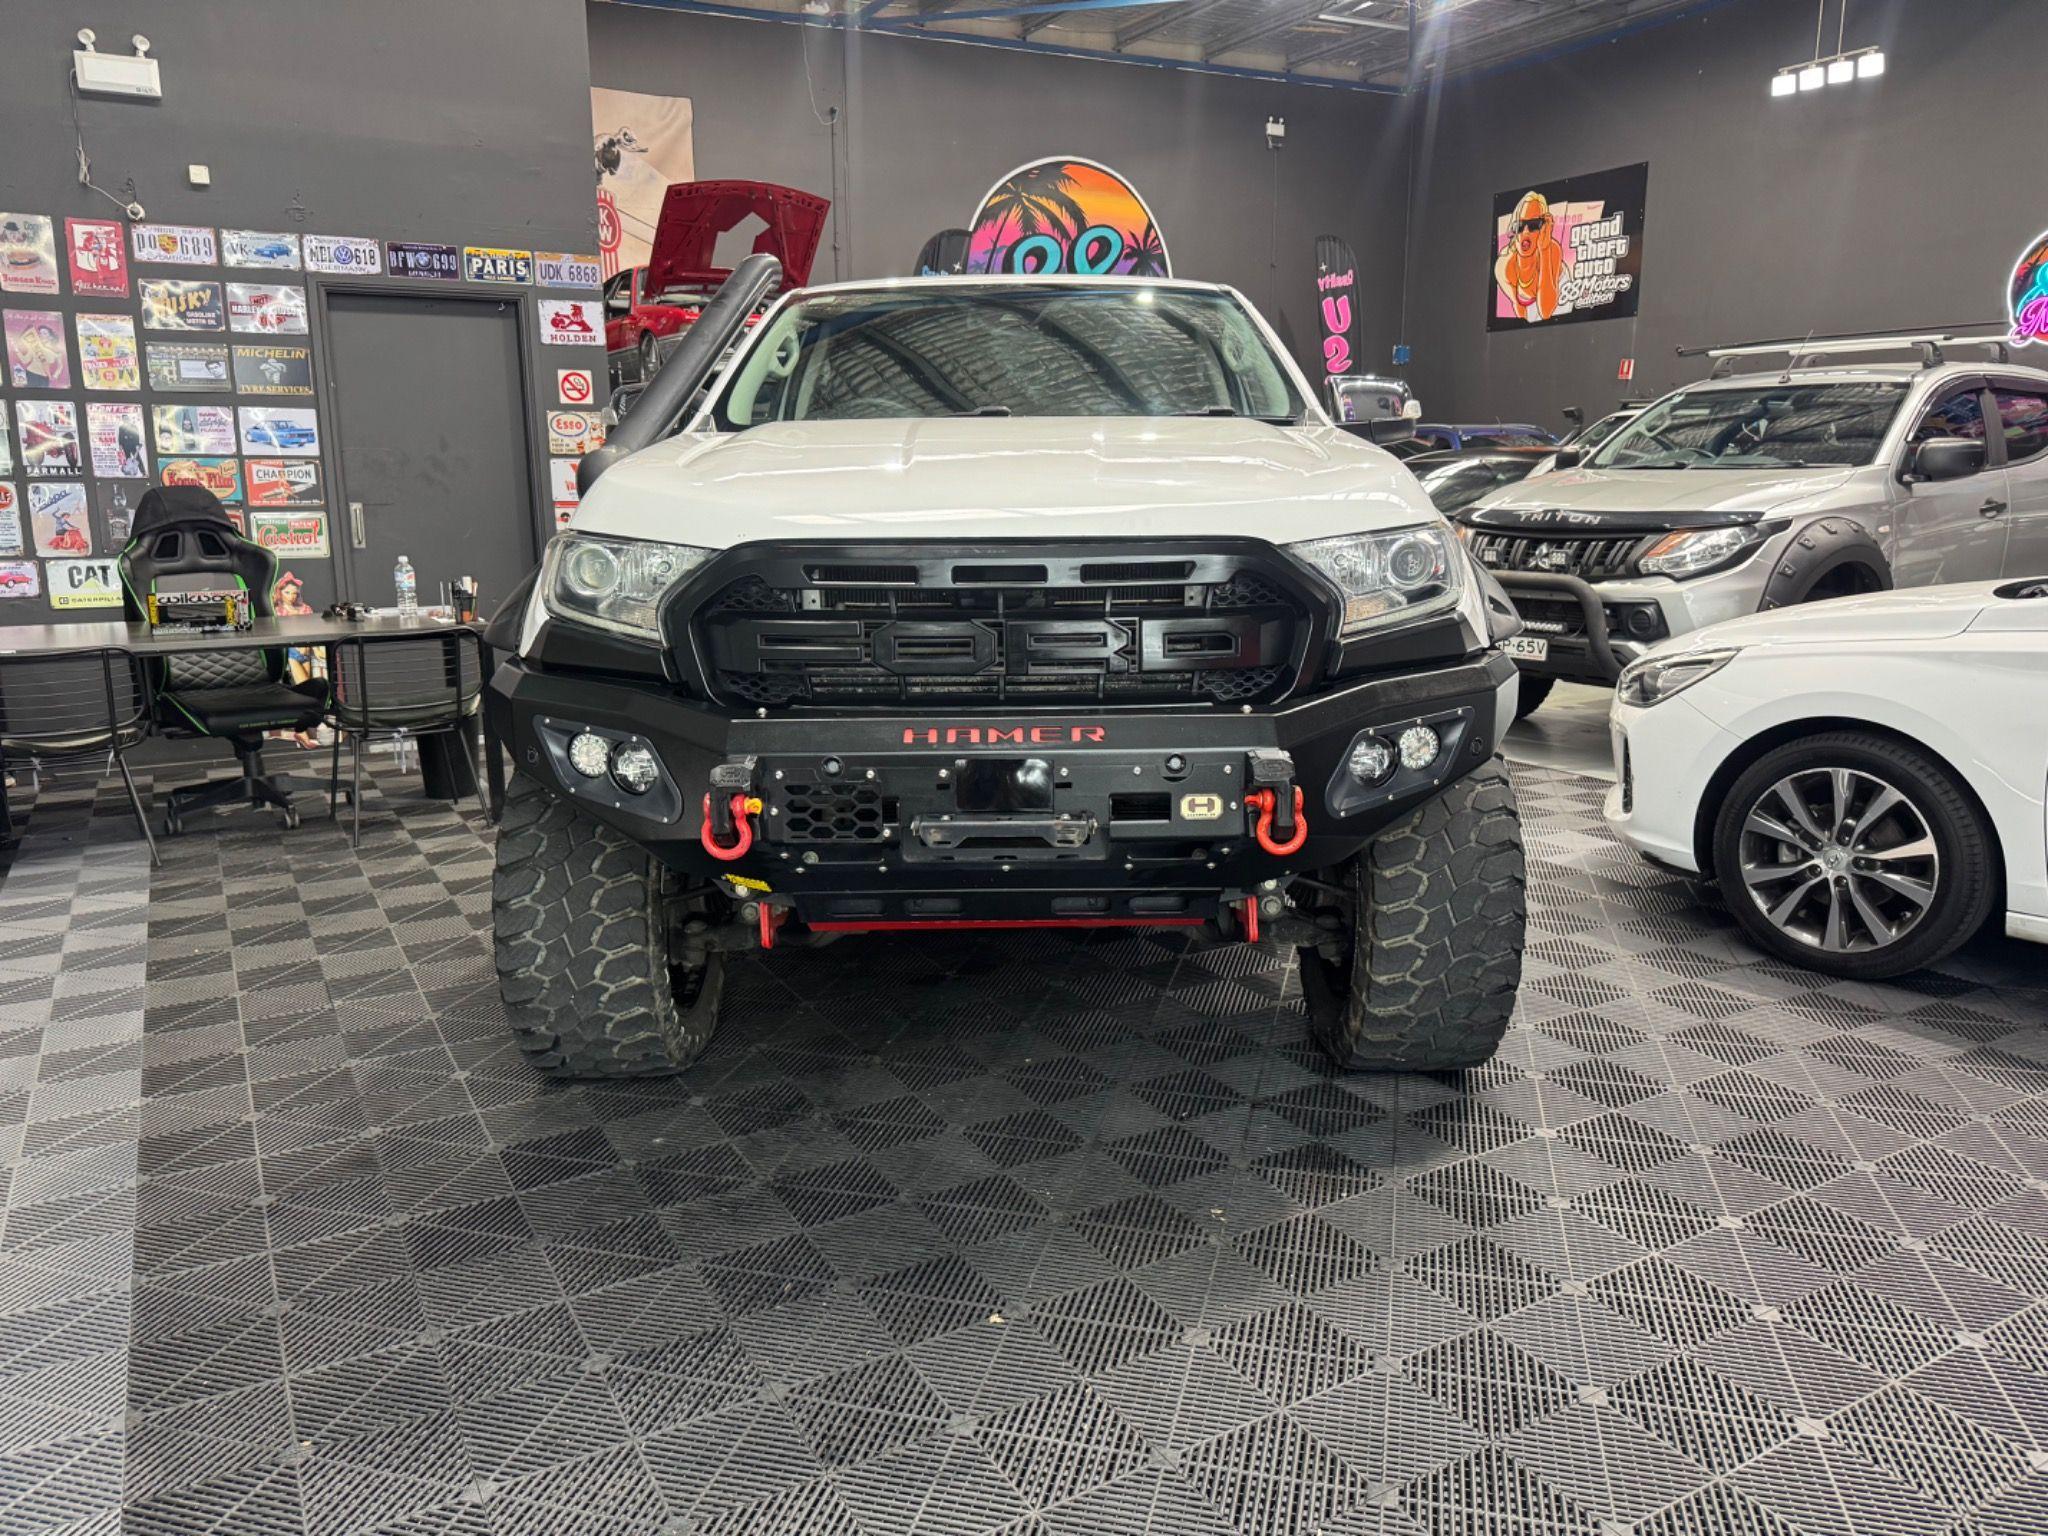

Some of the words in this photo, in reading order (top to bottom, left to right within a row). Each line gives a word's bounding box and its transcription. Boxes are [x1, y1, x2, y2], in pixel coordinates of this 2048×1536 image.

[180, 235, 212, 256] 689
[354, 248, 376, 265] 618
[432, 253, 457, 271] 699
[471, 257, 526, 275] PARIS
[540, 263, 563, 280] UDK
[568, 265, 597, 283] 6868
[549, 333, 596, 342] HOLDEN
[237, 348, 305, 359] MICHELIN
[240, 384, 265, 393] TYRE
[266, 385, 310, 394] SERVICES
[27, 467, 81, 476] FARMALL
[256, 468, 312, 480] CHAMPION
[1515, 512, 1601, 524] TRITON
[257, 519, 320, 546] Castrol
[68, 565, 111, 590] CAT
[712, 616, 1240, 676] FORD
[902, 726, 1106, 745] HAMER
